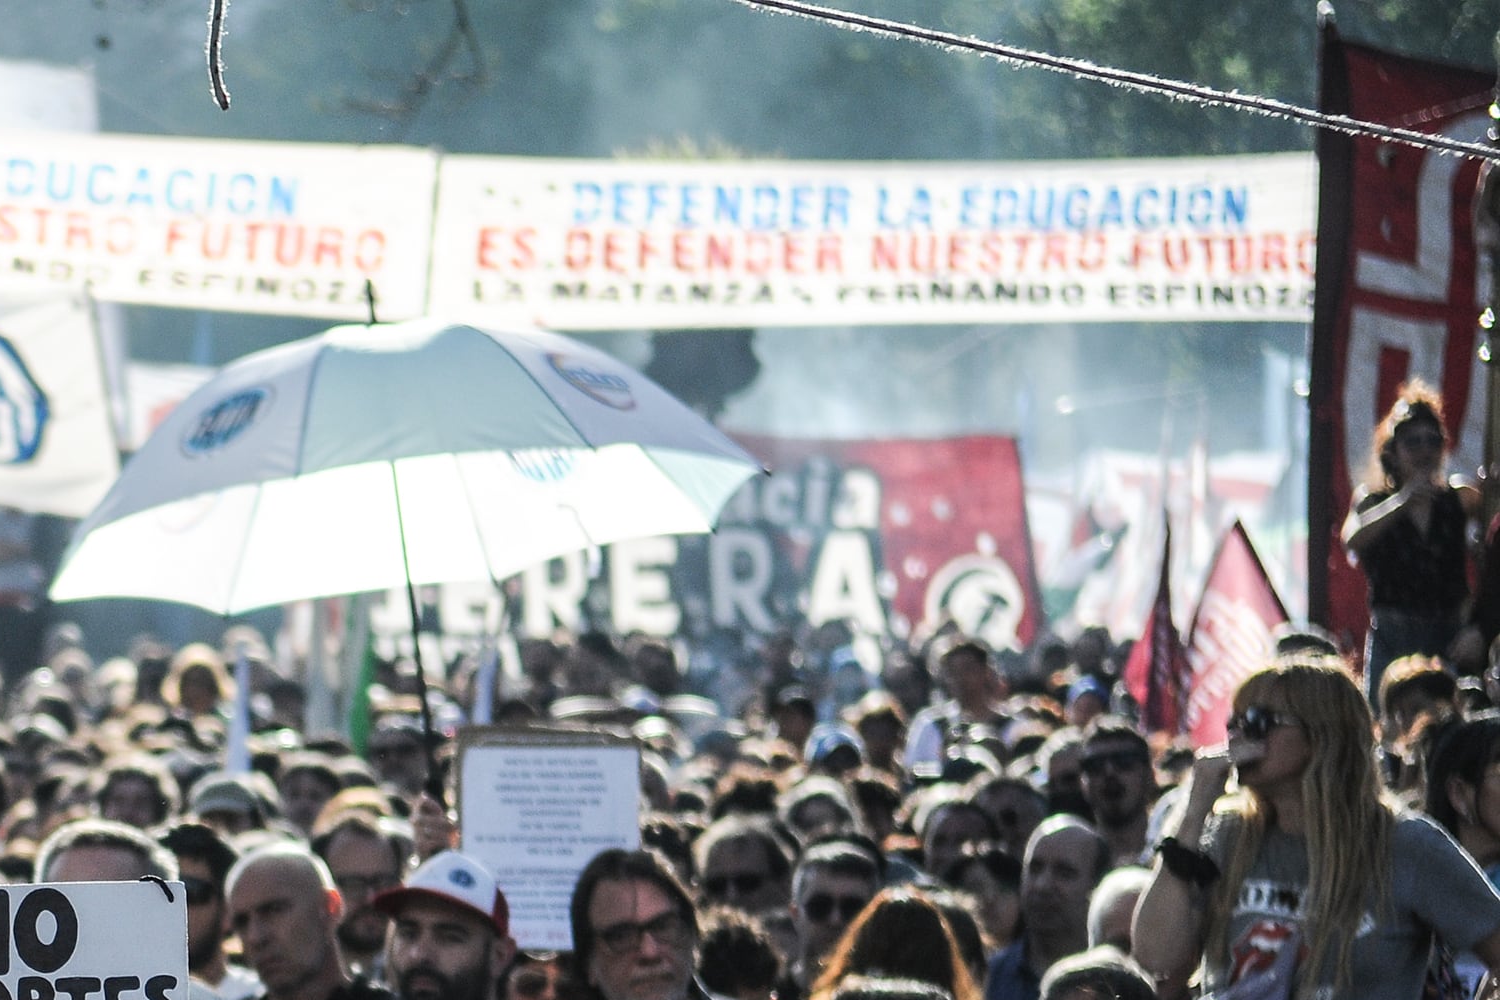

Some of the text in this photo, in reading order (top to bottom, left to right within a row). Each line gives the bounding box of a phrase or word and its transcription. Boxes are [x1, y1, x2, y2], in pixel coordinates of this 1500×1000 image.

[573, 180, 850, 229] DEFENDER
[876, 185, 932, 227] LA
[163, 221, 387, 272] FUTURO
[475, 226, 537, 271] ES
[563, 228, 843, 274] DEFENDER
[869, 232, 1108, 273] NUESTRO
[473, 278, 526, 304] LA
